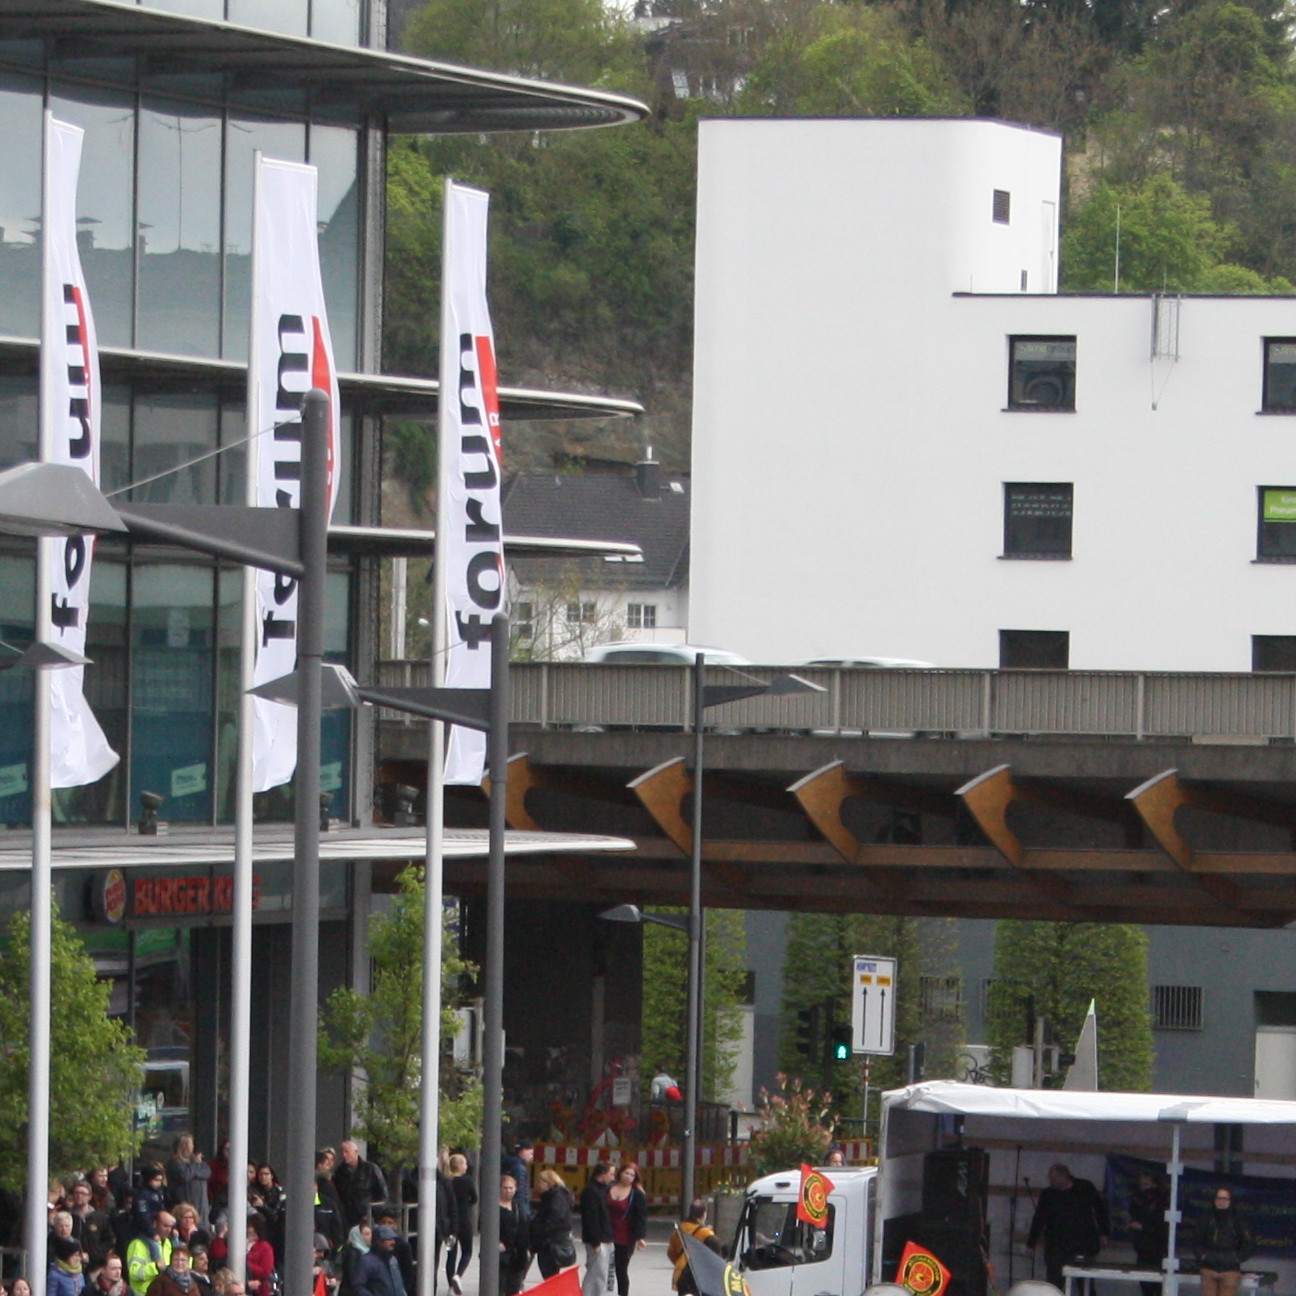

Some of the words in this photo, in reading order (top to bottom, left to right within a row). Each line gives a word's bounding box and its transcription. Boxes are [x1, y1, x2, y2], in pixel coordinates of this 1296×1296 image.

[51, 284, 91, 637] foum
[455, 333, 501, 651] forum
[135, 876, 210, 915] BURGER
